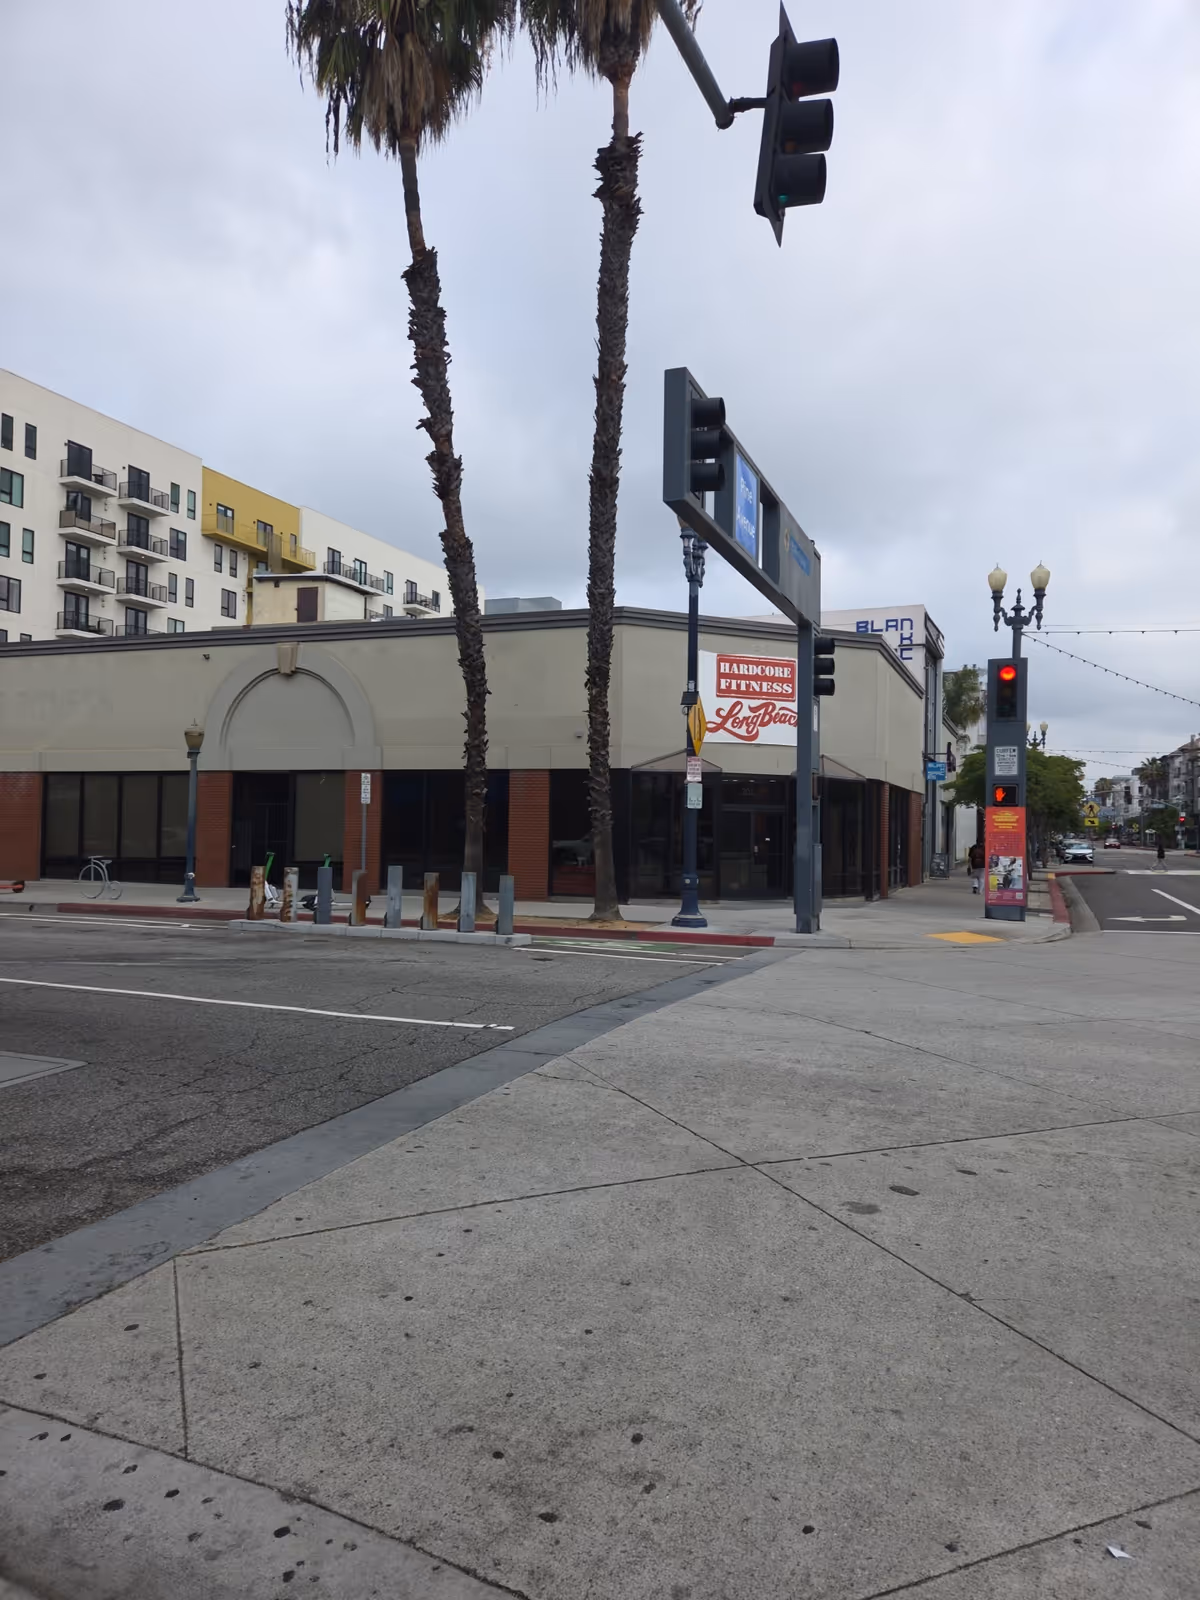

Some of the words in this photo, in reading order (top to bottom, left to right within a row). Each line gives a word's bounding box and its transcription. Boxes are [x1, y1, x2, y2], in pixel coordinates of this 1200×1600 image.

[740, 477, 753, 503] Pine
[736, 504, 756, 538] Avenue
[719, 662, 791, 678] HARDCORE
[719, 678, 793, 694] FITNESS
[706, 700, 762, 742] Long
[748, 701, 798, 728] Beac
